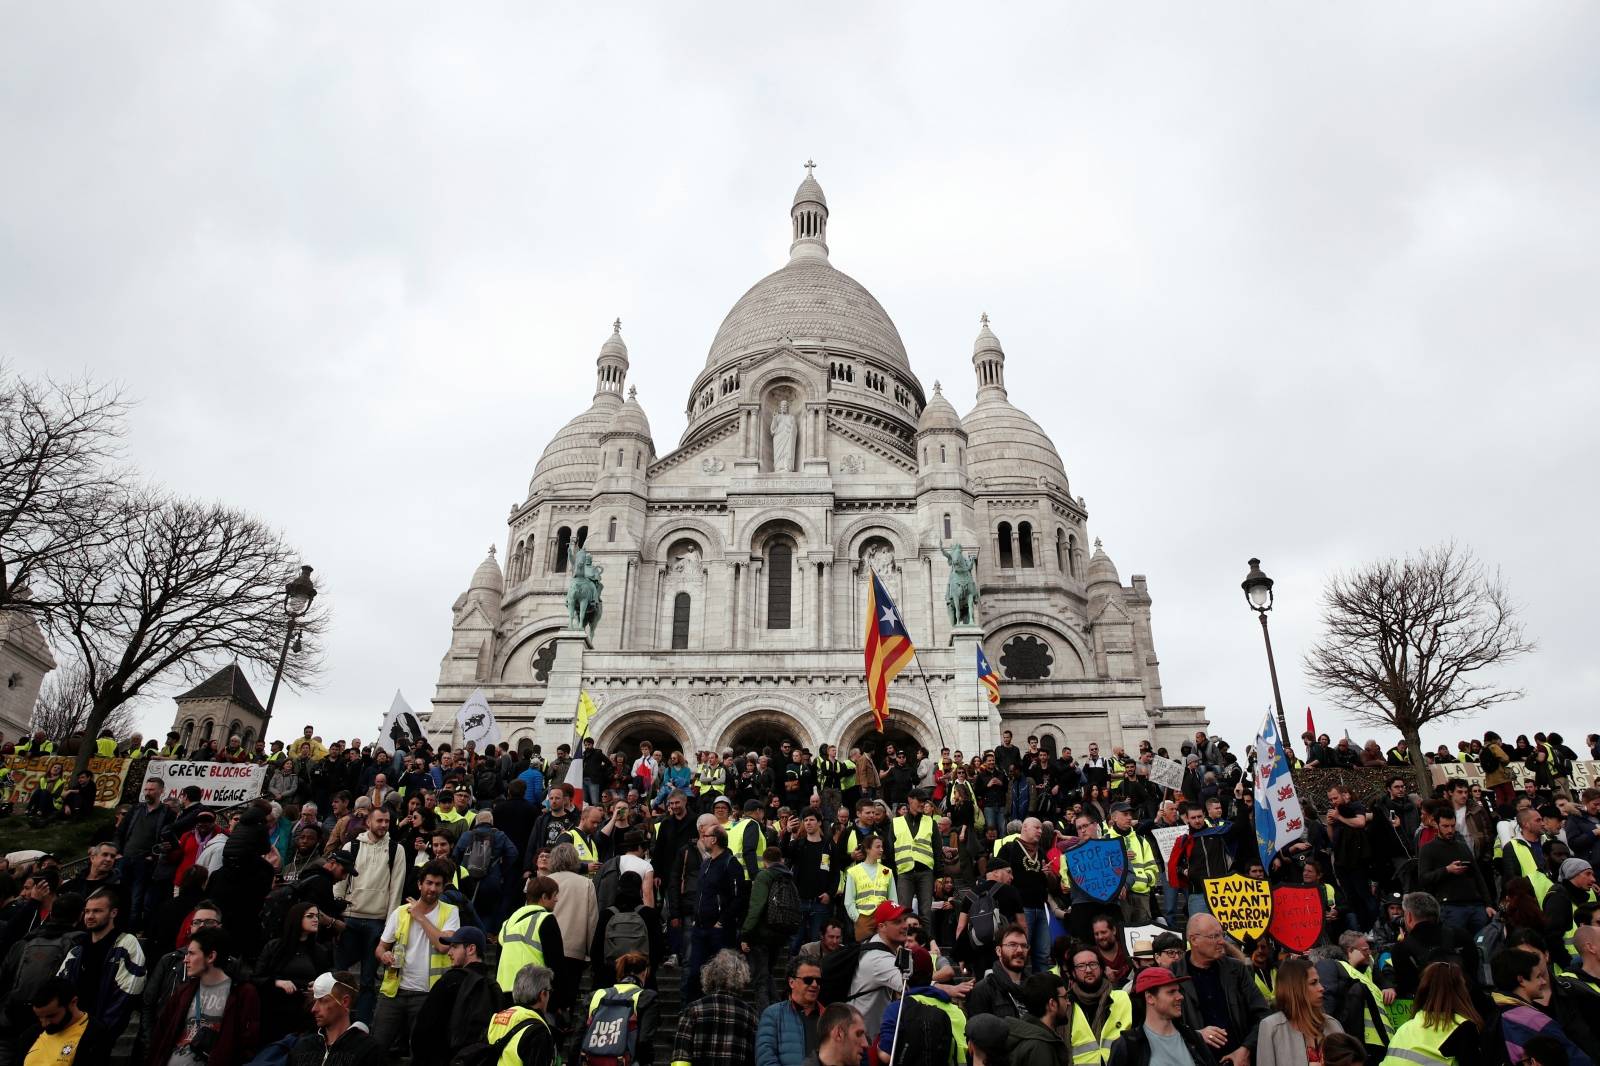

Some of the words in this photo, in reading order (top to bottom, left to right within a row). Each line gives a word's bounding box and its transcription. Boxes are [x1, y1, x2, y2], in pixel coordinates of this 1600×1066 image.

[168, 762, 208, 777] GRÈVE
[1444, 764, 1465, 776] LA
[213, 786, 247, 802] DÉGAGE
[1071, 846, 1102, 865] STOP
[1209, 880, 1264, 894] JAUNE
[1210, 894, 1270, 908] DEVANT
[1217, 907, 1270, 921] MACRON
[592, 1017, 623, 1034] JUST
[588, 1034, 608, 1047] DO
[609, 1030, 621, 1045] IT
